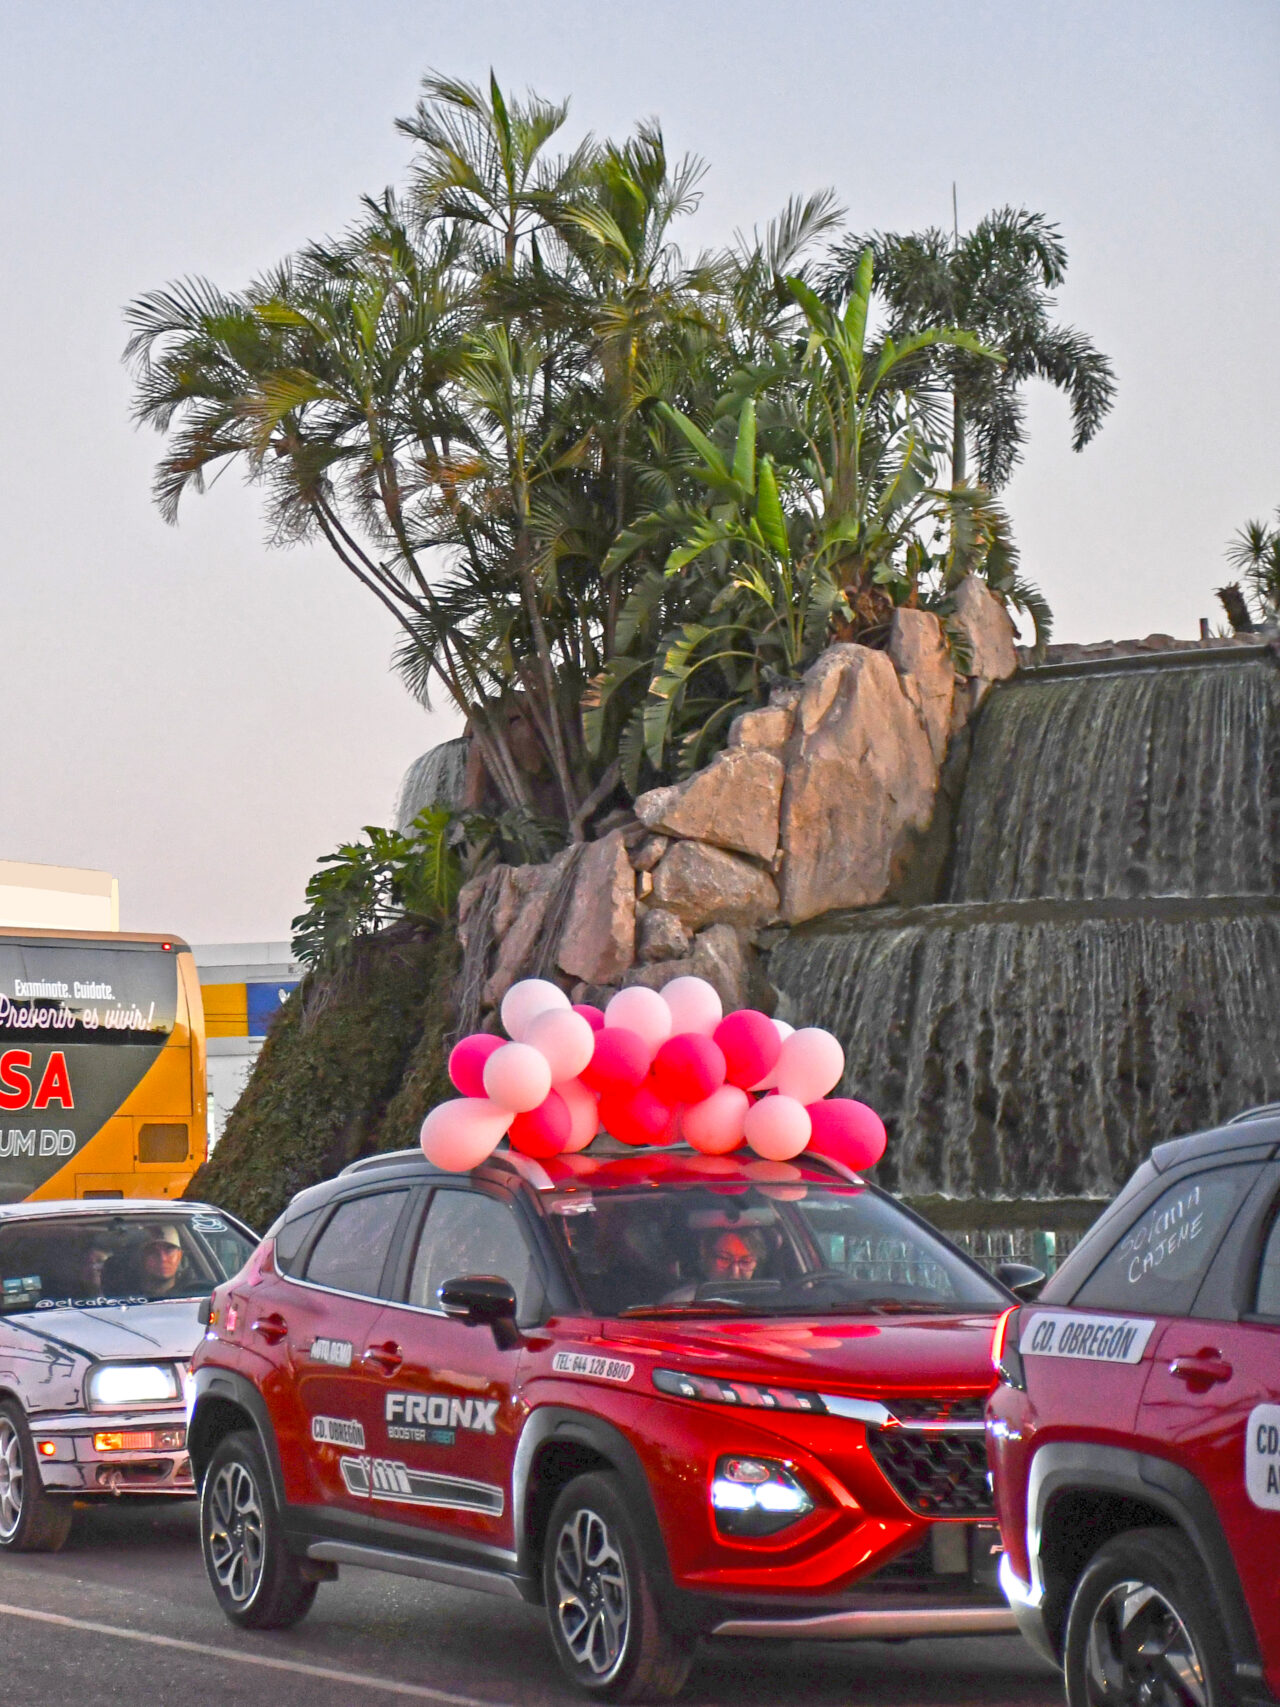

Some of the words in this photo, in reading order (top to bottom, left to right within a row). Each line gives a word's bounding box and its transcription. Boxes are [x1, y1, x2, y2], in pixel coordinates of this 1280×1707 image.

[82, 1007, 100, 1029] es
[39, 1129, 77, 1157] DD
[1031, 1320, 1056, 1353] CD.
[1058, 1320, 1138, 1360] OBREGÓN
[572, 1356, 588, 1373] 644
[588, 1358, 606, 1376] 128
[606, 1361, 632, 1380] 8800
[385, 1392, 500, 1435] FRONX
[328, 1418, 365, 1446] OBREGÓN
[387, 1425, 426, 1442] BOOSTER
